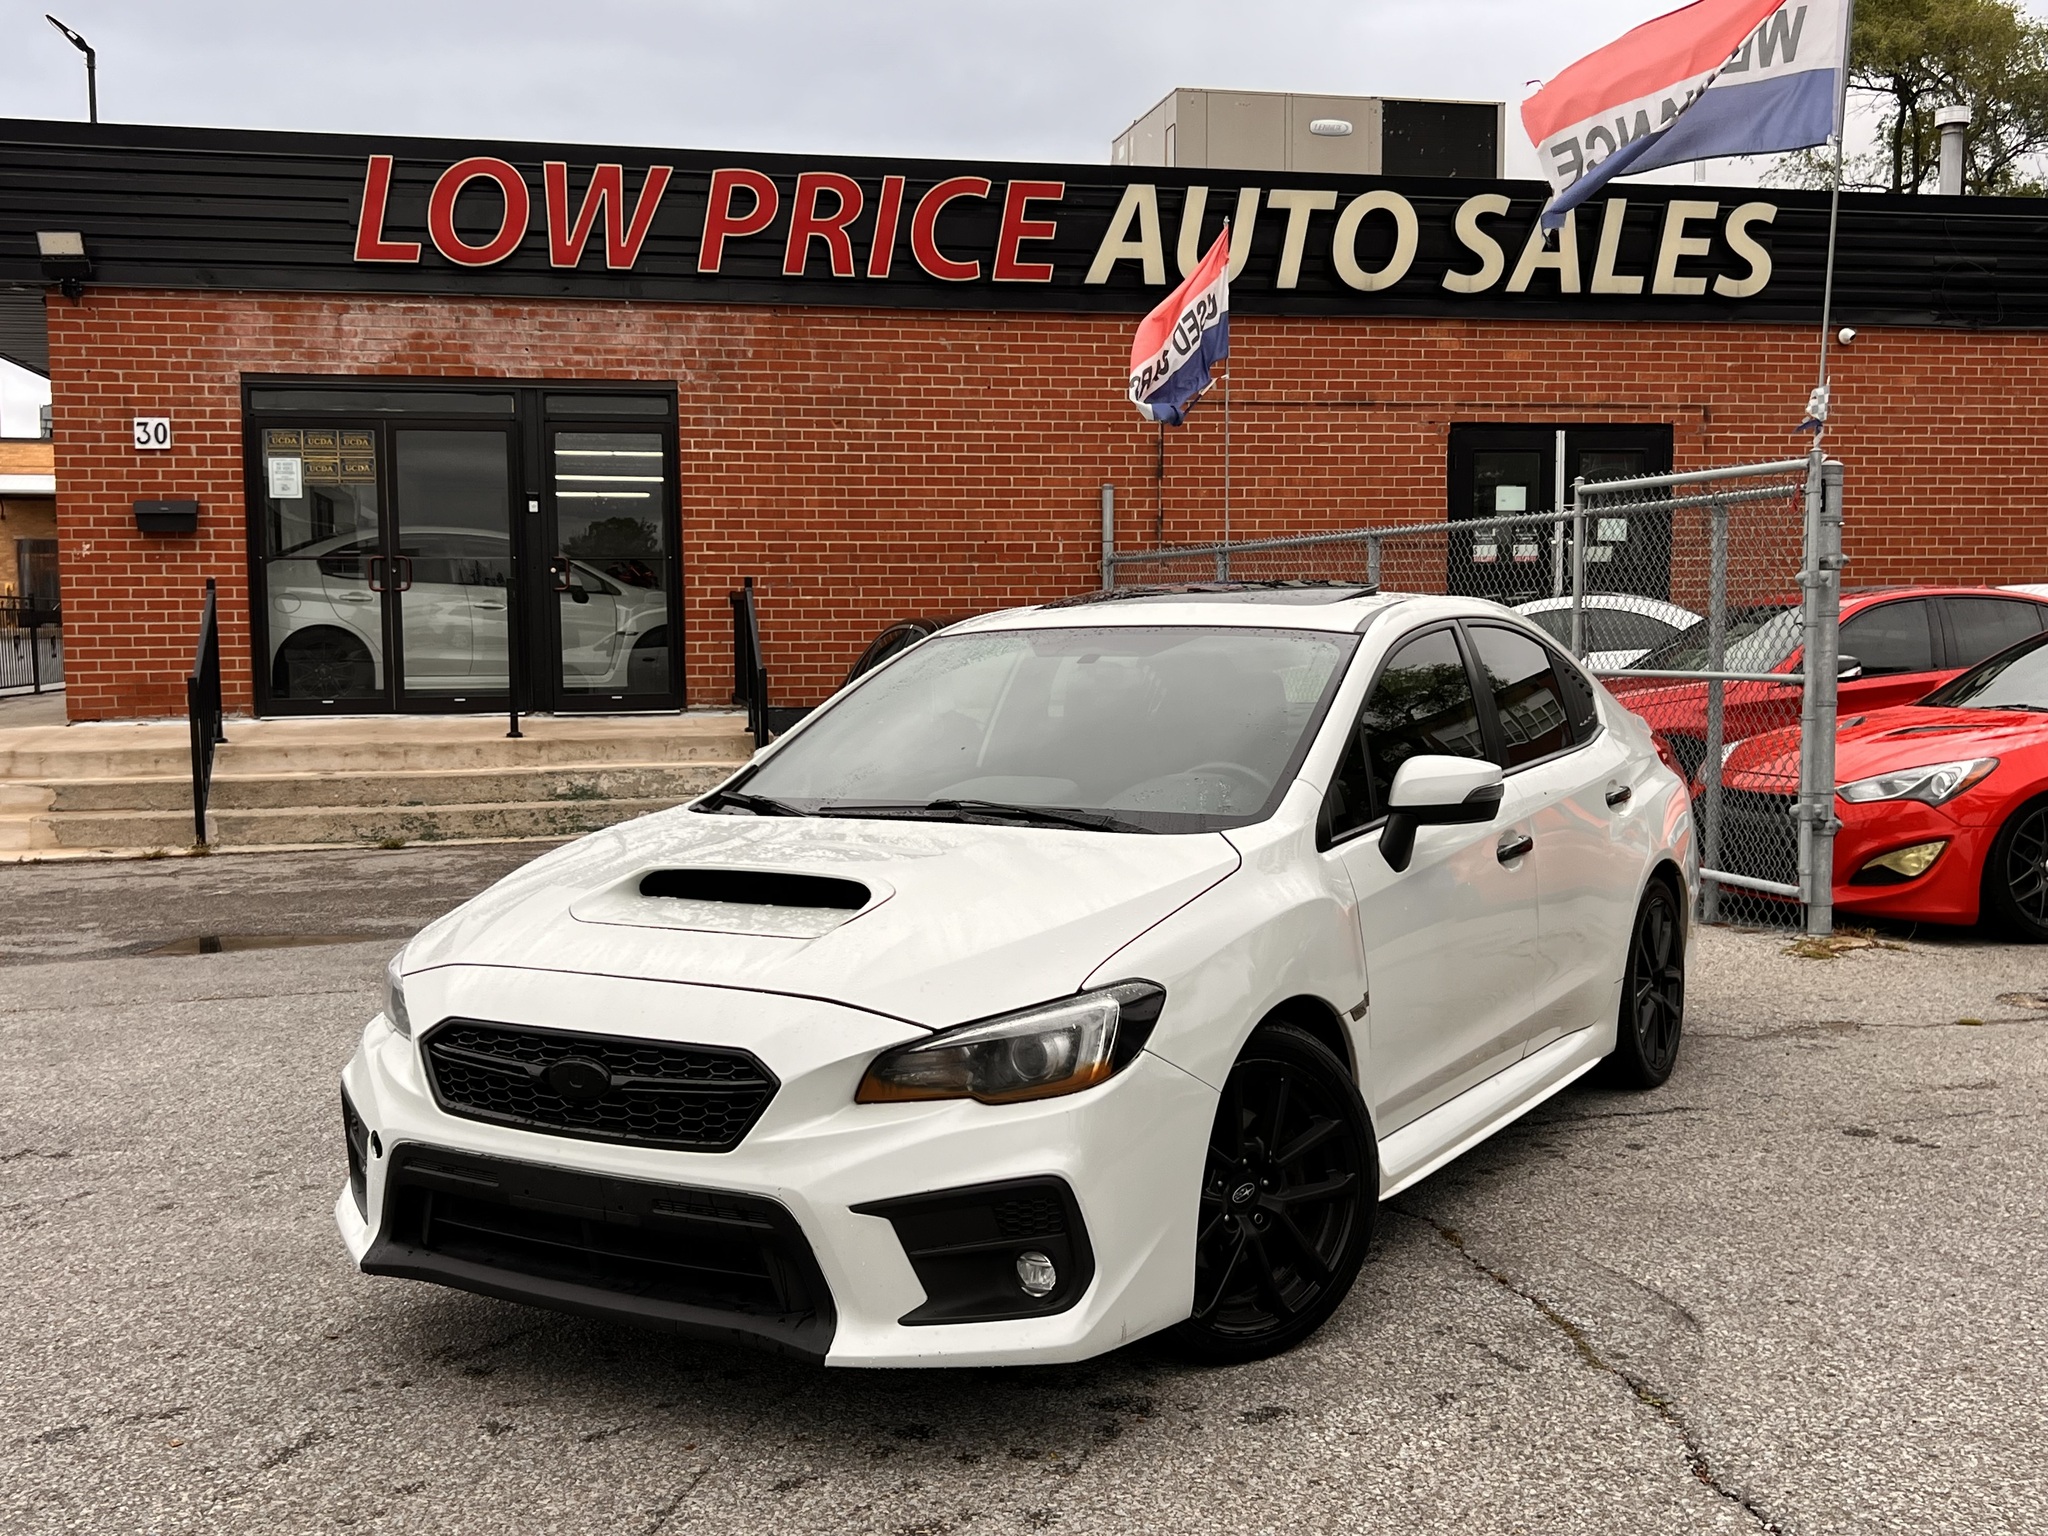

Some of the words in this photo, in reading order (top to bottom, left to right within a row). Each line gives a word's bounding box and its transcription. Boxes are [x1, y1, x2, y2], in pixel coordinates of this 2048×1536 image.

[353, 154, 674, 270] LOW
[697, 168, 1066, 282] PRICE
[1084, 183, 1419, 292] AUTO
[1441, 193, 1778, 298] SALES
[136, 422, 168, 445] 30
[271, 436, 298, 445] UCDA
[345, 464, 371, 472] UCDA
